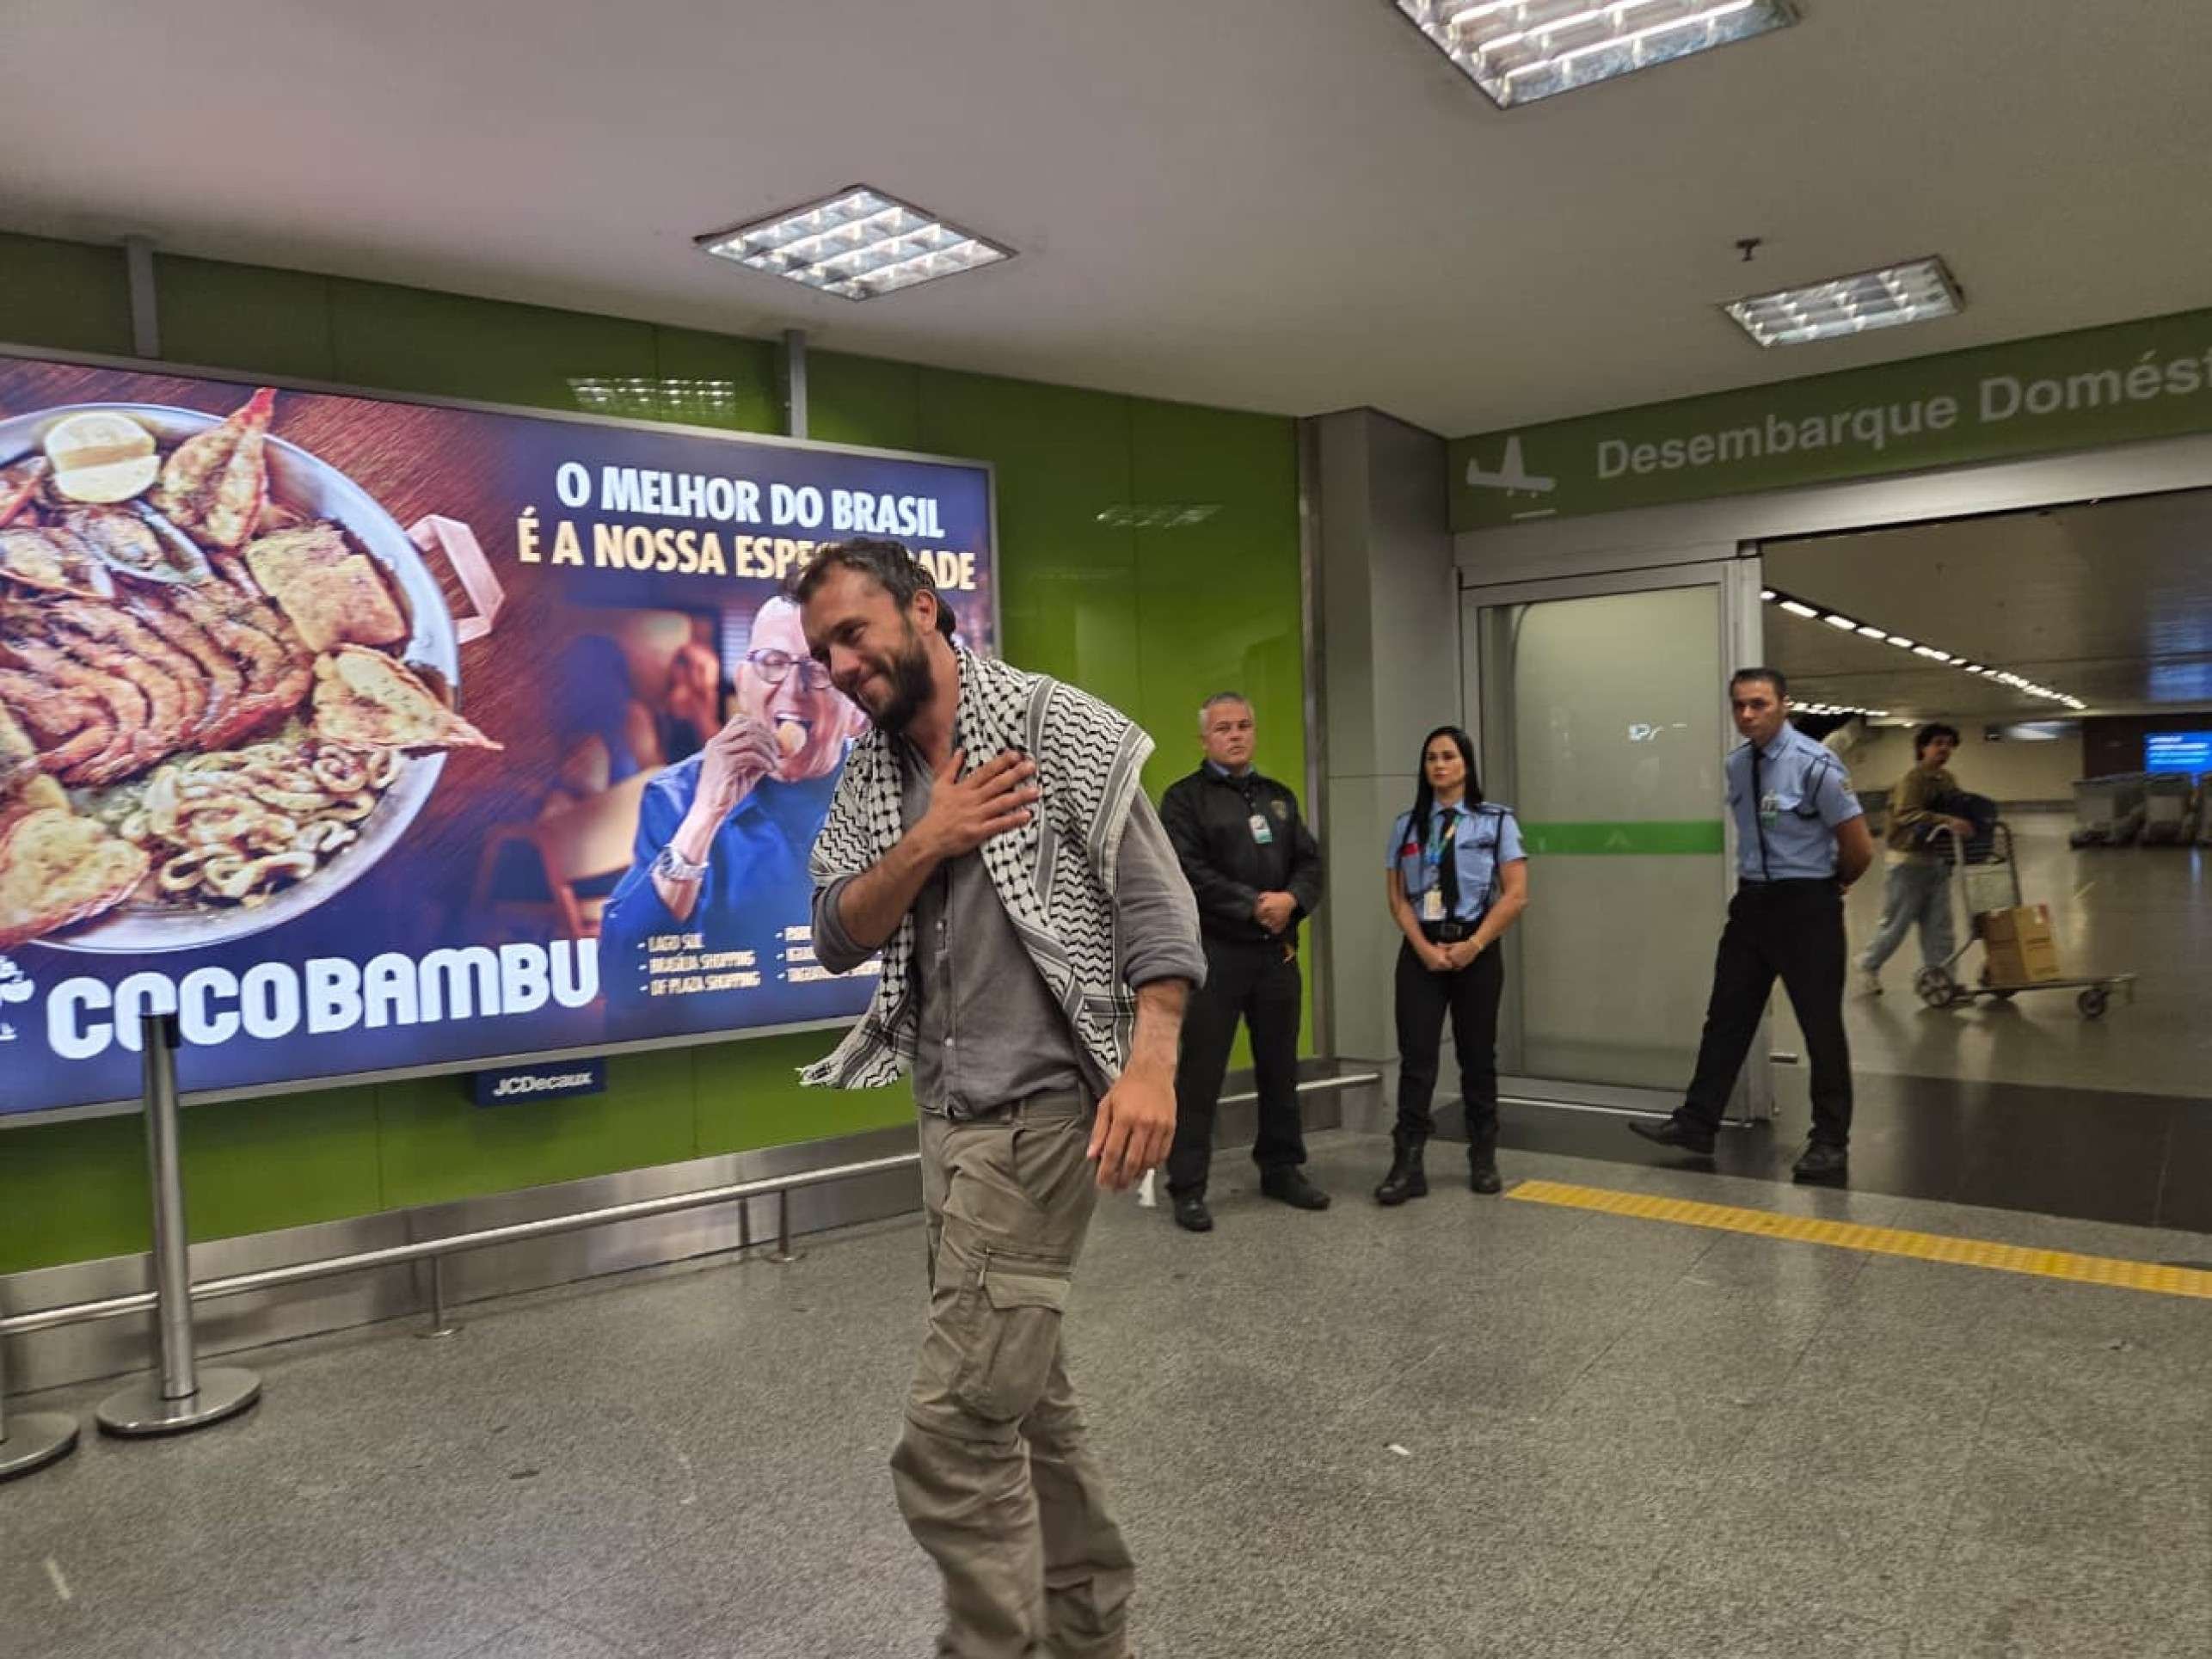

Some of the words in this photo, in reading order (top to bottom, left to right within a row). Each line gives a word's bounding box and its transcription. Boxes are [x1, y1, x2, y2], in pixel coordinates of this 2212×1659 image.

[1596, 395, 1959, 479] Desembarque
[556, 462, 591, 507] O
[601, 466, 762, 523] MELHOR
[771, 483, 824, 528] DO
[831, 489, 944, 538] BRASIL
[518, 506, 542, 562] É
[551, 520, 585, 566] A
[593, 523, 728, 575] NOSSA
[493, 1072, 593, 1096] JCDecaux
